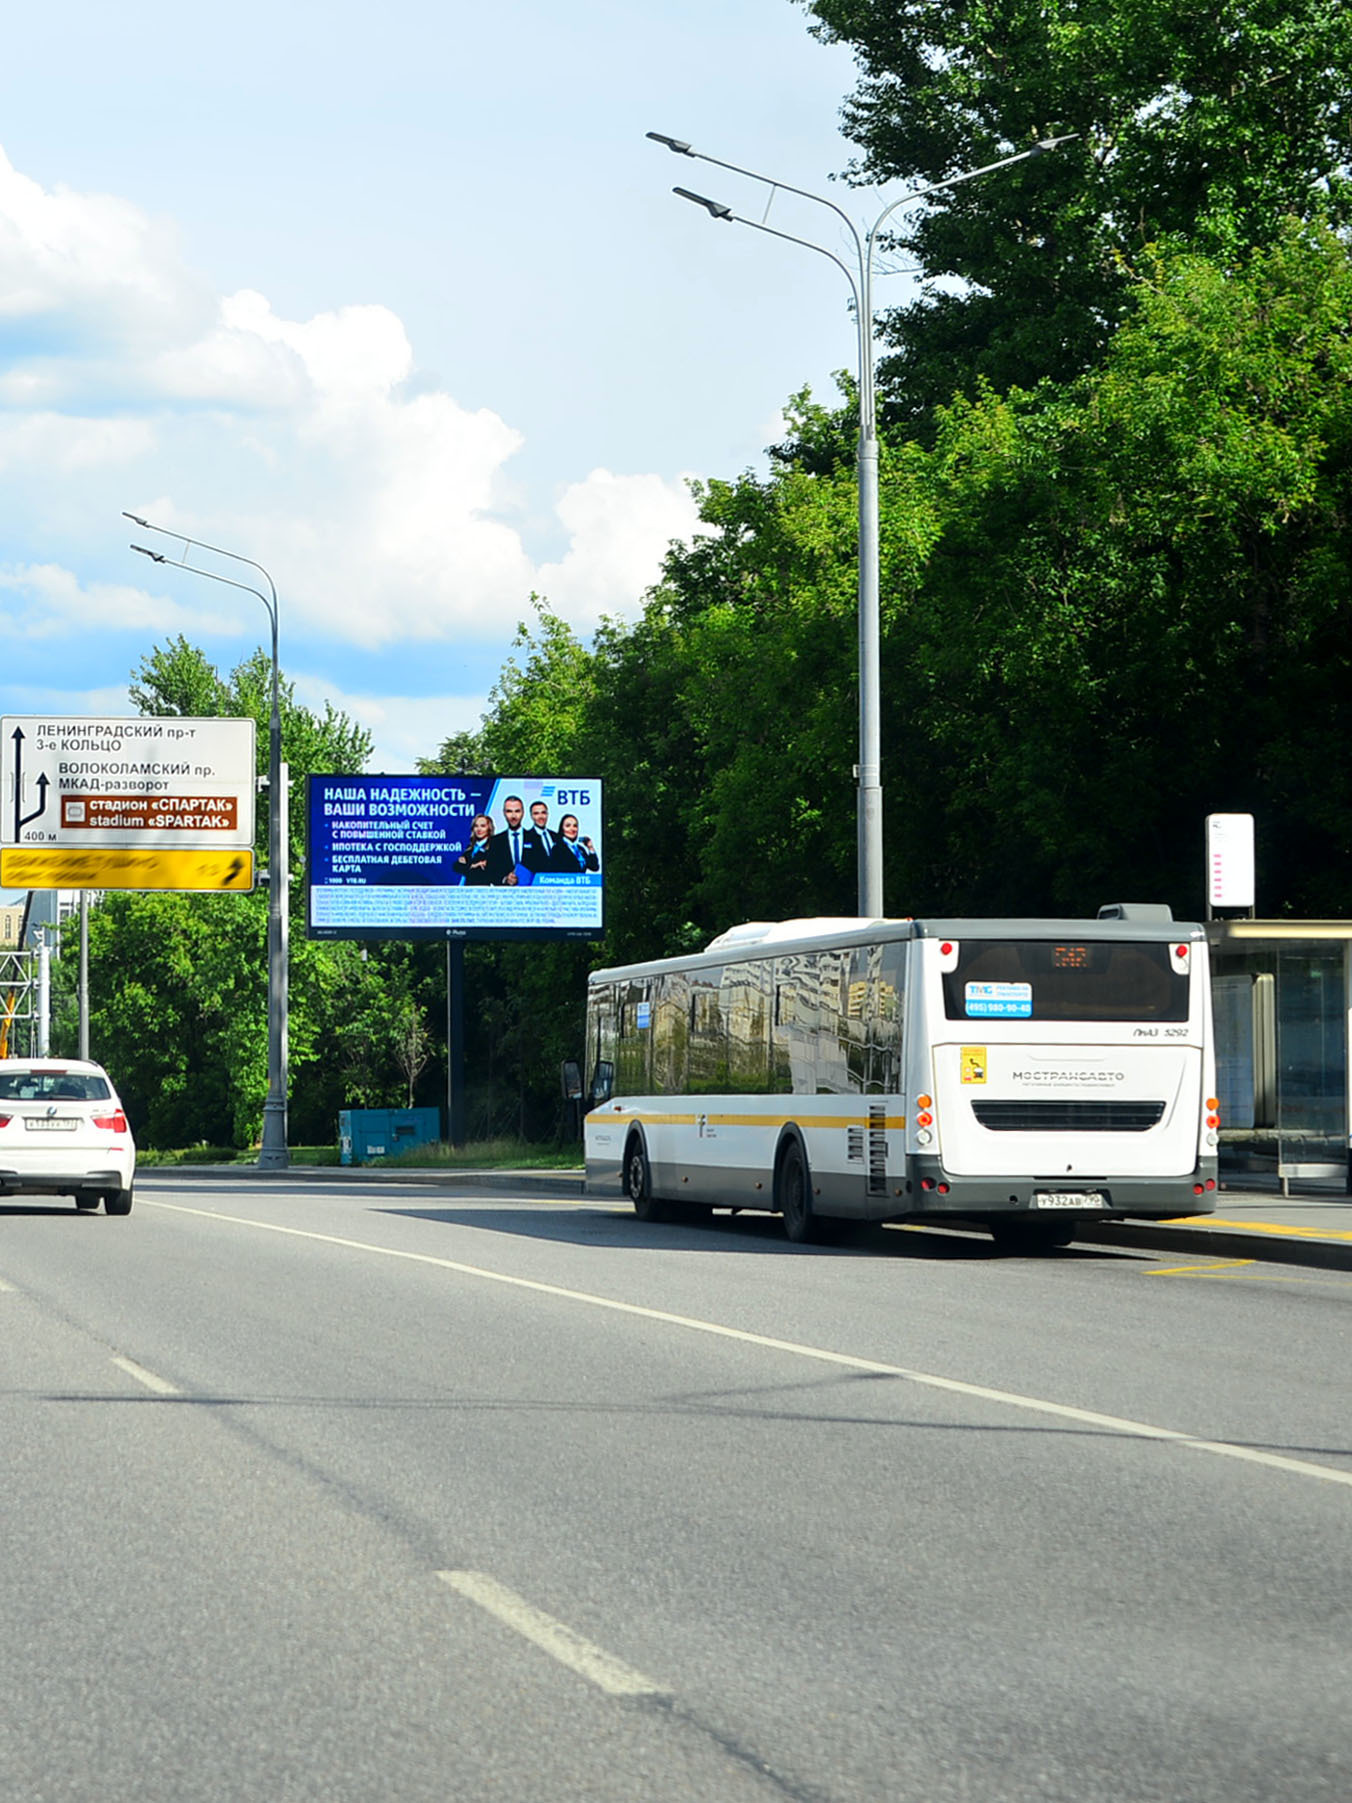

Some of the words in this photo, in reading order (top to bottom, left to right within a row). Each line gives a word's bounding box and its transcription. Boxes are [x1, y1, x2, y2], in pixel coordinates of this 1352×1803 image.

[37, 724, 163, 738] ЛЕНИНГРАДСКИЙ
[167, 729, 196, 739] пр-т
[36, 739, 57, 750] 3-е
[61, 739, 121, 752] КОЛЬЦО
[59, 761, 190, 775] ВОЛОКОЛАМСКИЙ
[195, 766, 215, 778] пр.
[59, 778, 169, 792] МКАД-разворот
[324, 788, 367, 800] НАША
[370, 788, 466, 802] НАДЕЖНОСТЬ
[557, 790, 591, 805] ВТБ
[89, 801, 148, 812] стадион
[151, 798, 233, 812] «СПАРТАК»
[324, 803, 365, 816] ВАШИ
[369, 803, 475, 817] ВОЗМОЖНОСТИ
[89, 814, 144, 827] stadium
[148, 814, 230, 828] «SPARTAK»
[332, 820, 410, 830] НАКОПИТЕЛЬНЫЙ
[412, 821, 434, 830] СЧЕТ
[24, 831, 45, 841] 400
[332, 831, 338, 839] С
[340, 830, 404, 840] ПОВЫШЕННОЙ
[406, 830, 446, 840] СТАВКОЙ
[332, 843, 373, 851] ИПОТЕКА
[375, 843, 382, 851] С
[383, 842, 462, 853] ГОСПОДДЕРЖКОЙ
[332, 855, 389, 864] БЕСПЛАТНАЯ
[391, 855, 442, 865] ДЕБЕТОВАЯ
[332, 865, 362, 873] КАРТА
[539, 876, 575, 886] Команда
[576, 876, 591, 885] ВТБ
